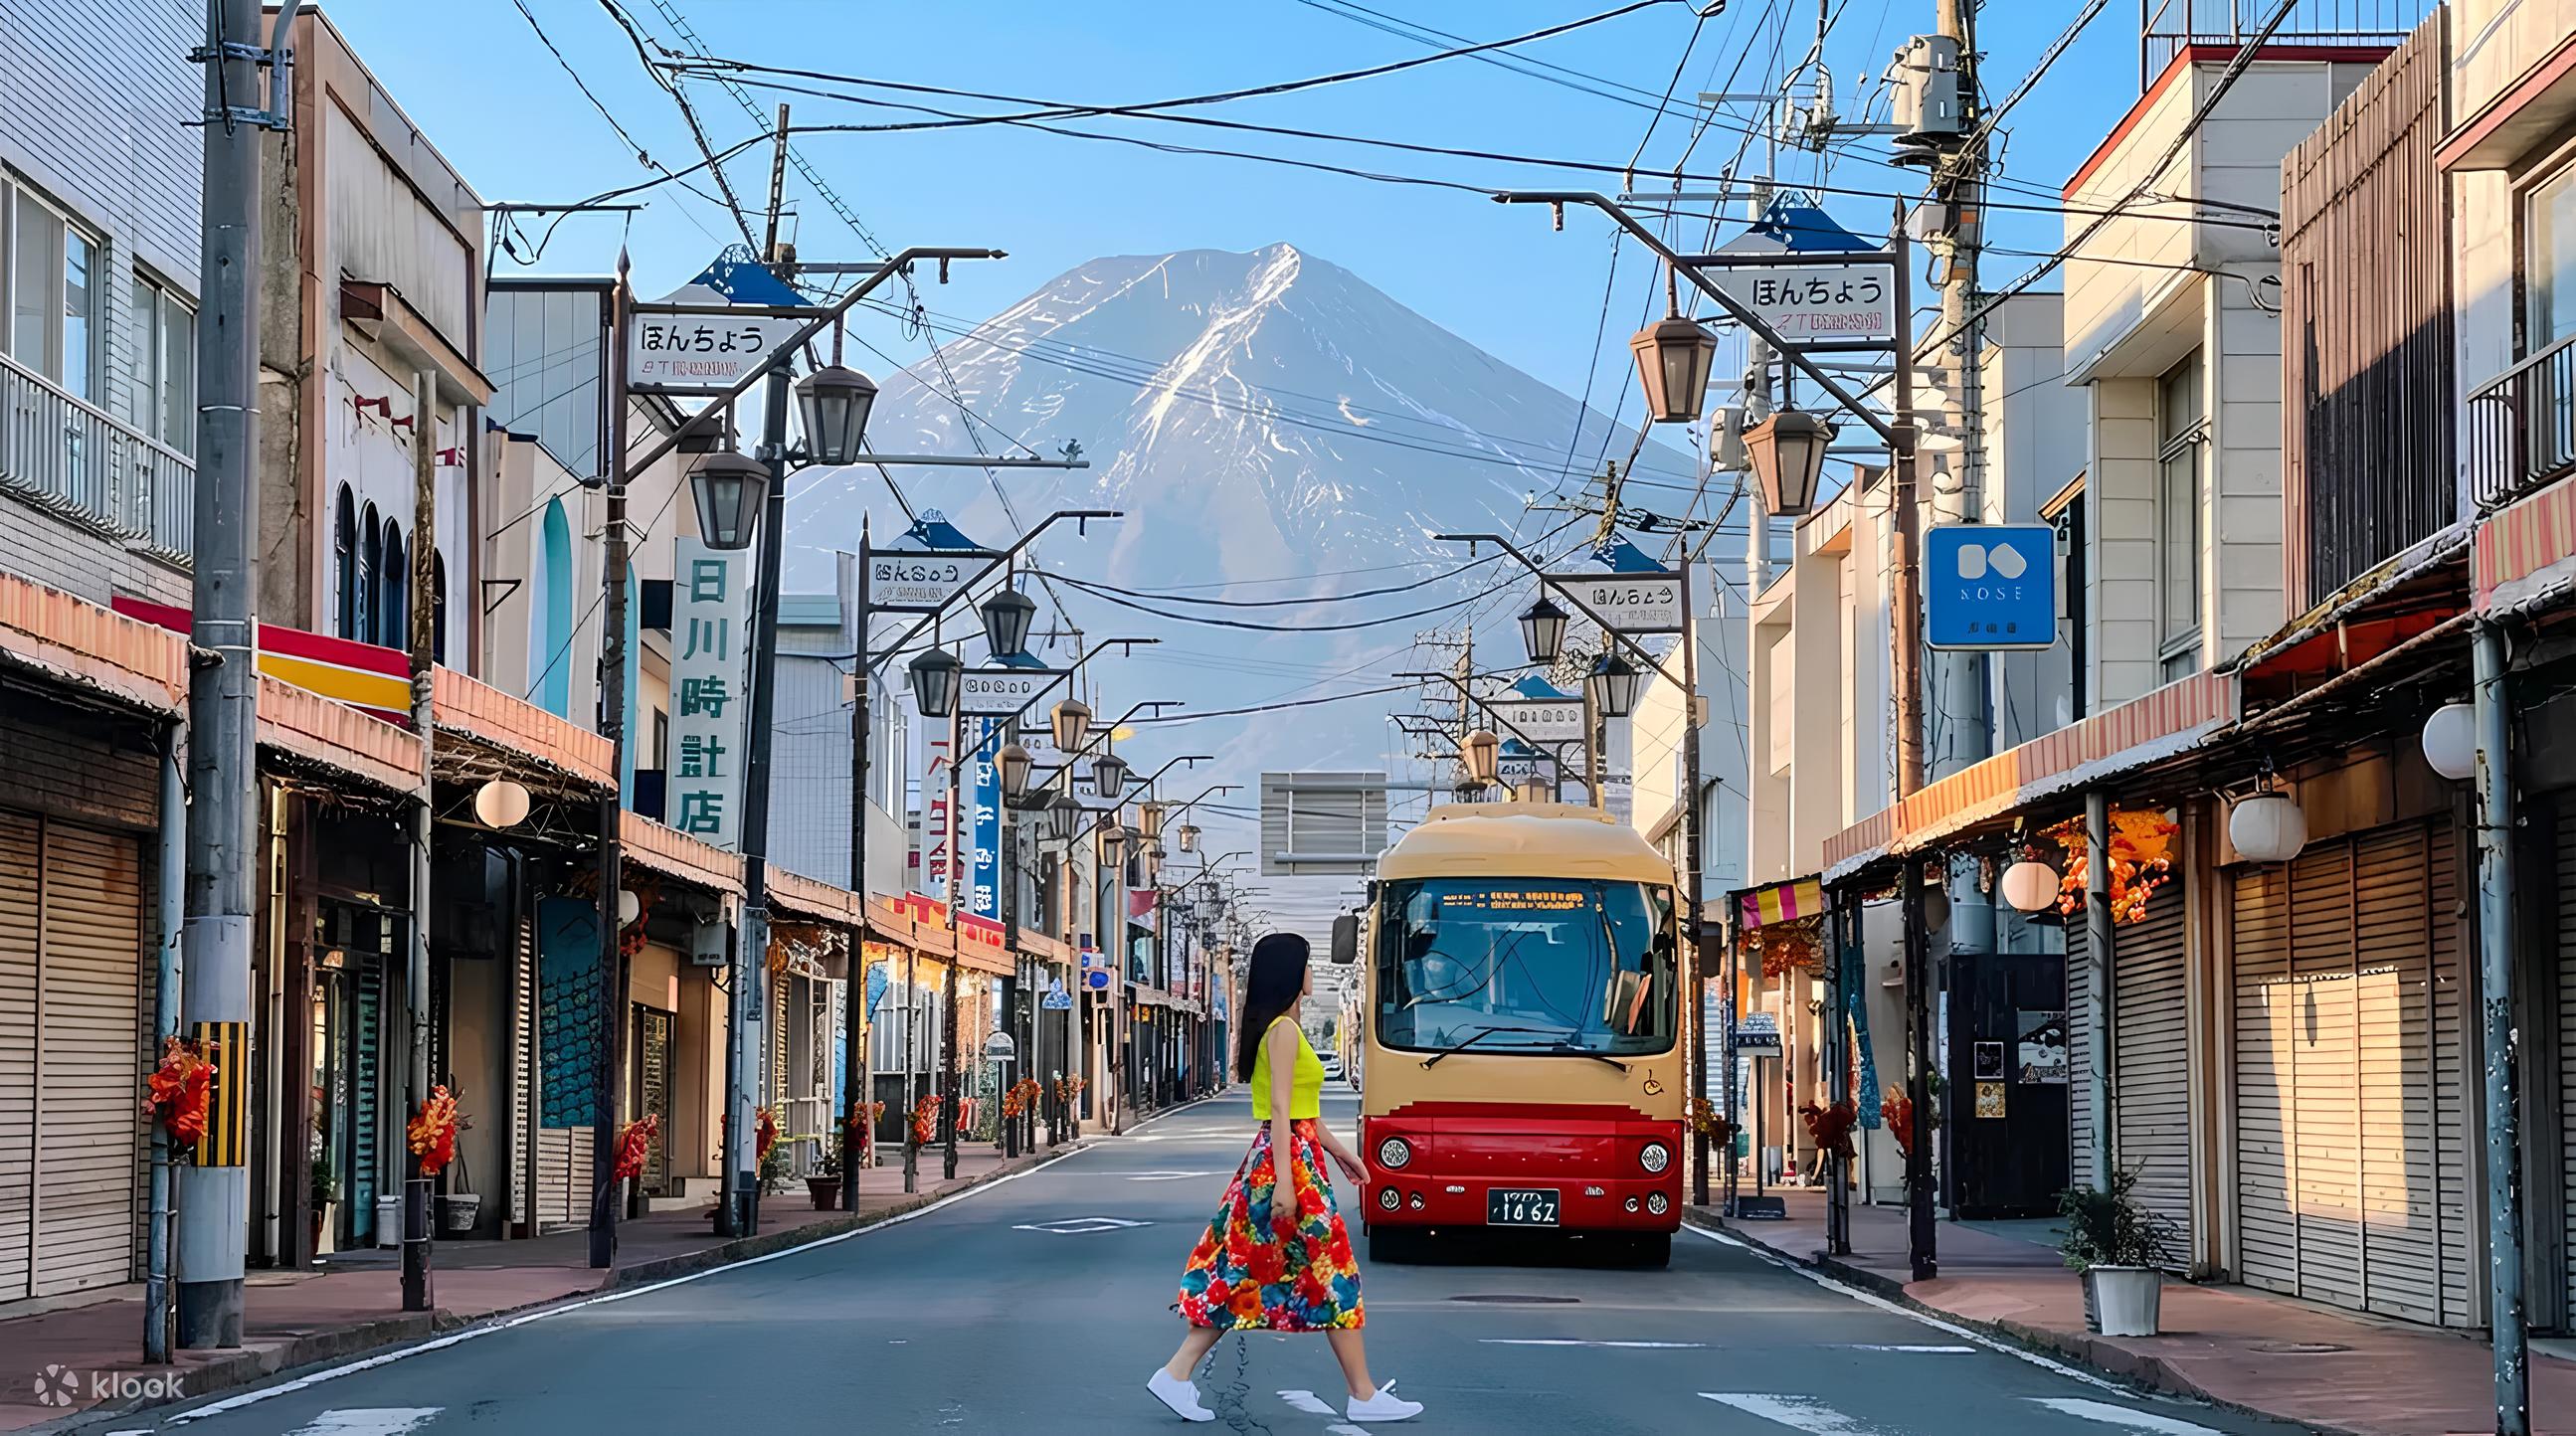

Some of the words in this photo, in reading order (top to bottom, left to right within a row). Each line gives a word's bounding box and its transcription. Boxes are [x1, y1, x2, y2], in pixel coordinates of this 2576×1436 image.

[1752, 276, 1883, 306] ほんちょう
[642, 323, 763, 353] ほんちょう
[674, 558, 732, 835] 日川時計店
